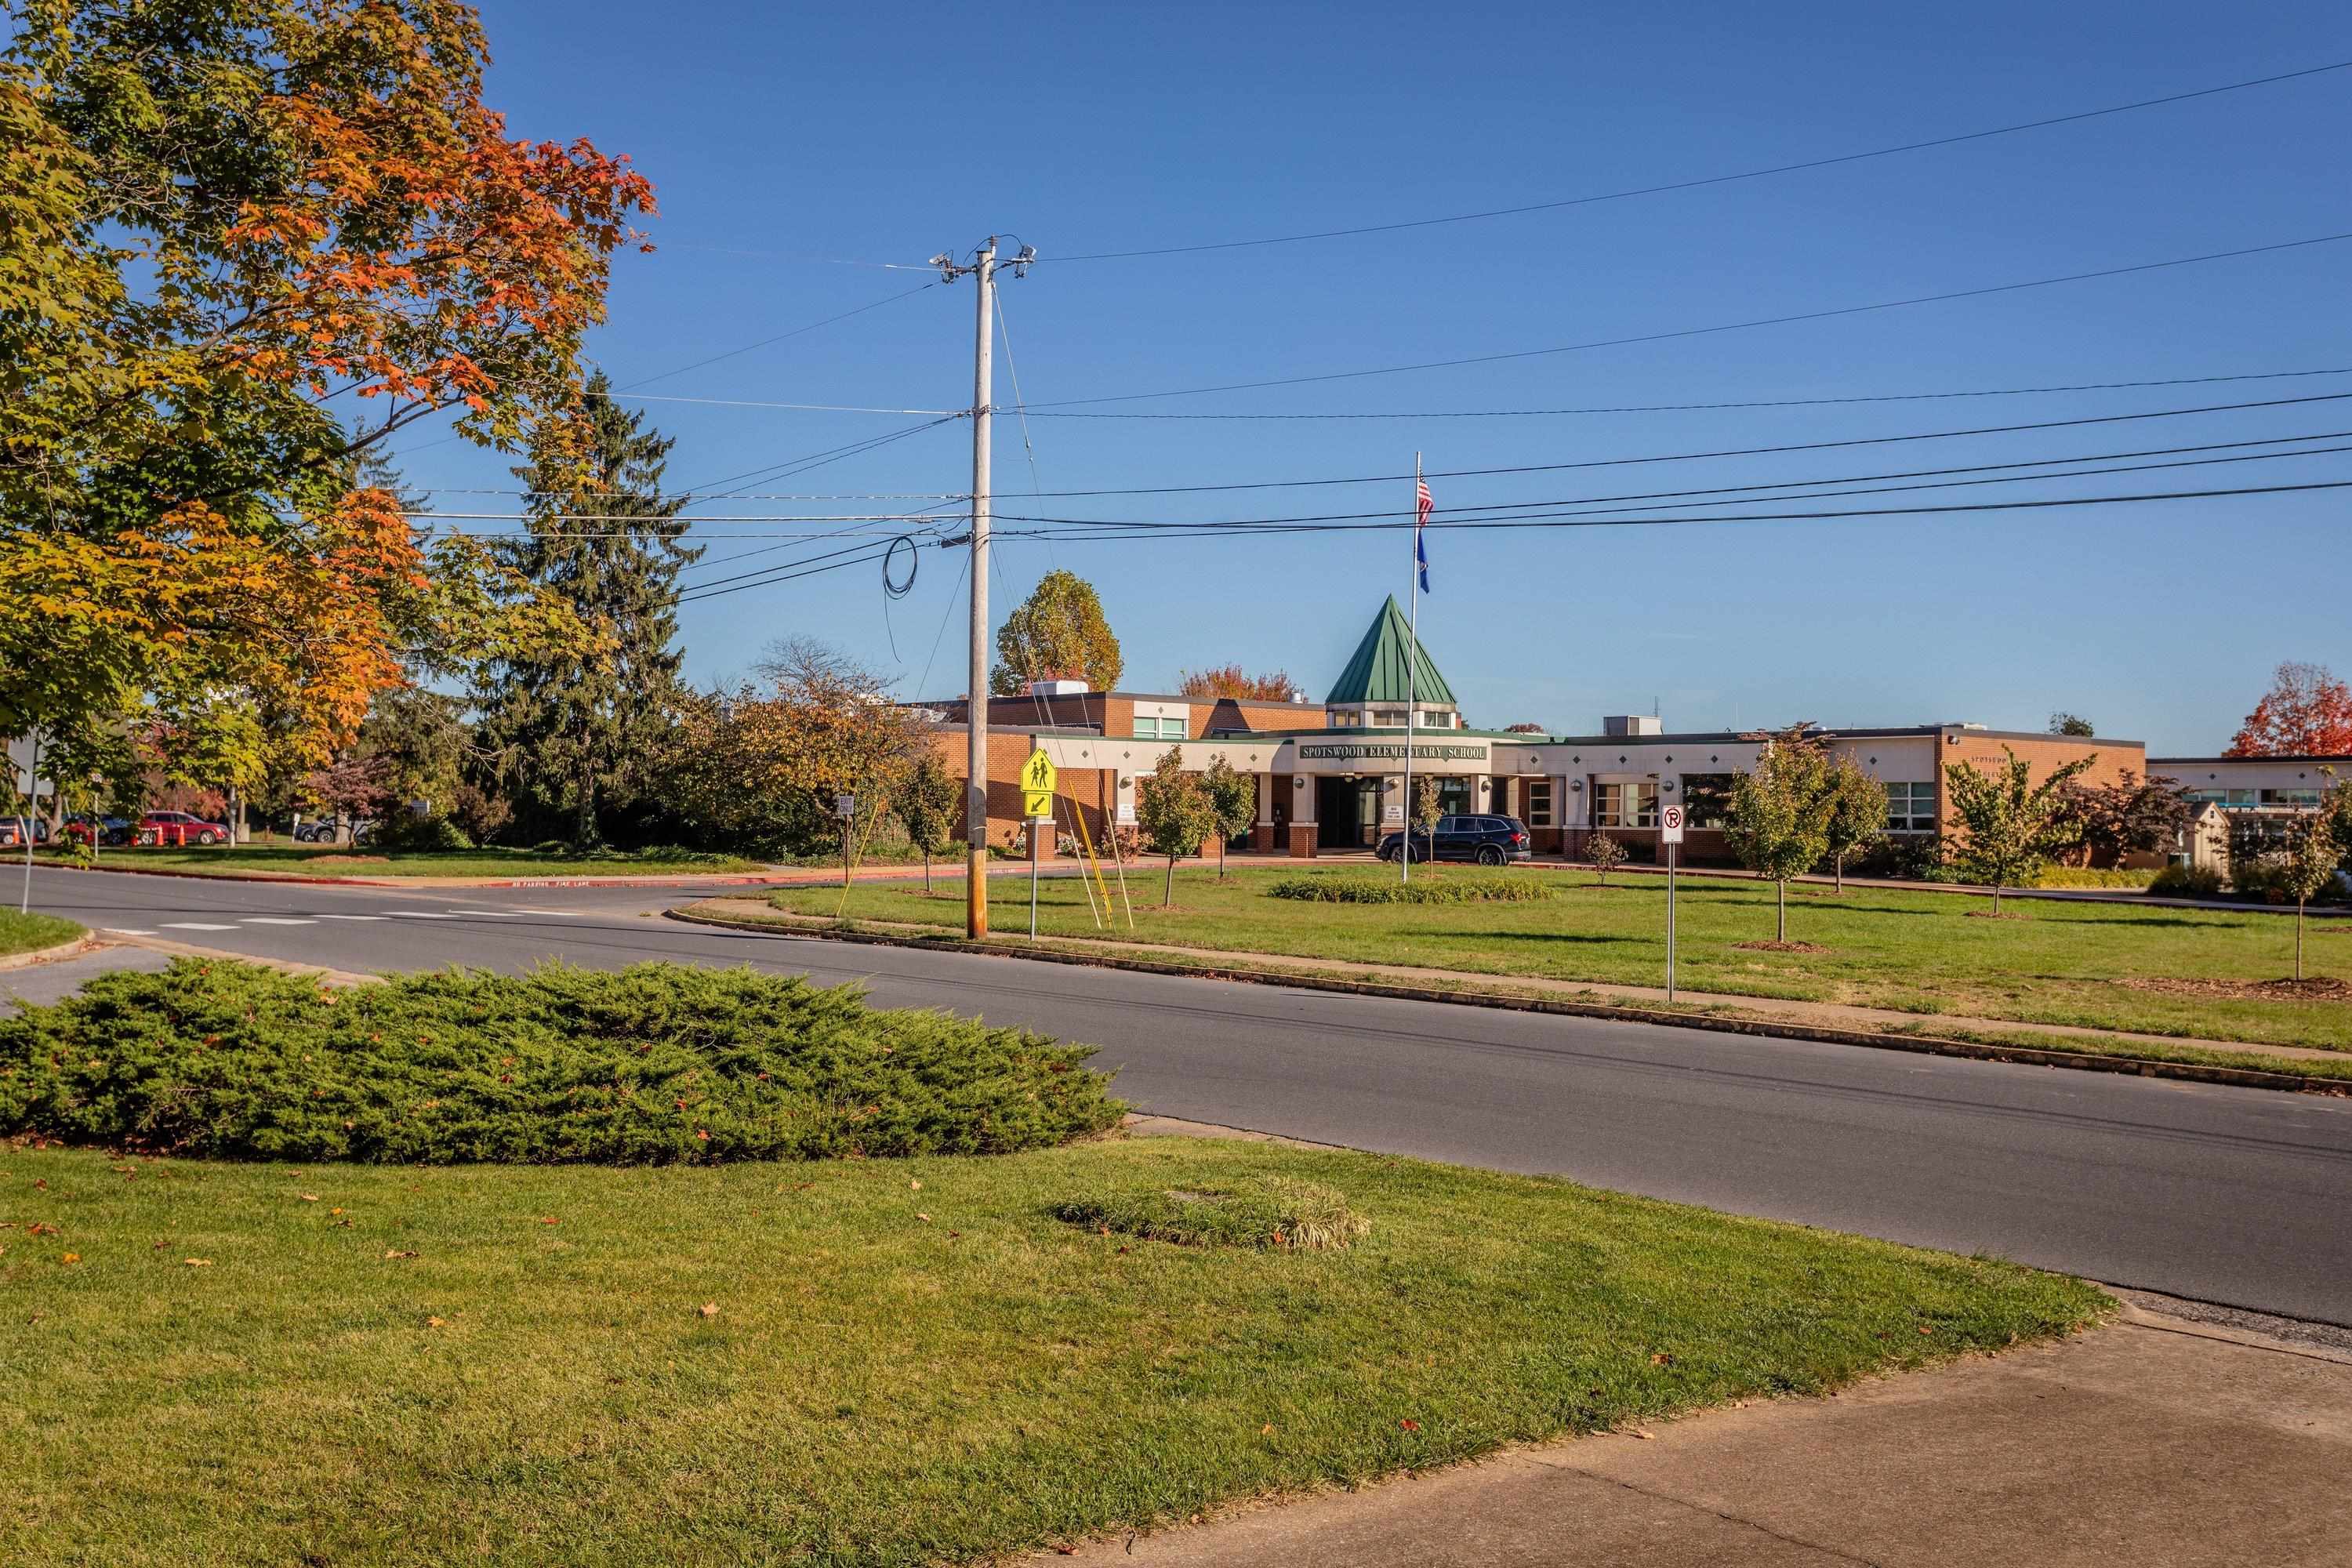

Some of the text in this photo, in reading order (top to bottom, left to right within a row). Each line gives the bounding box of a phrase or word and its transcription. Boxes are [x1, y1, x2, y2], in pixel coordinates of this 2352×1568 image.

[1304, 746, 1484, 758] SPOTSWOOD ELEMETARY SCHOOL
